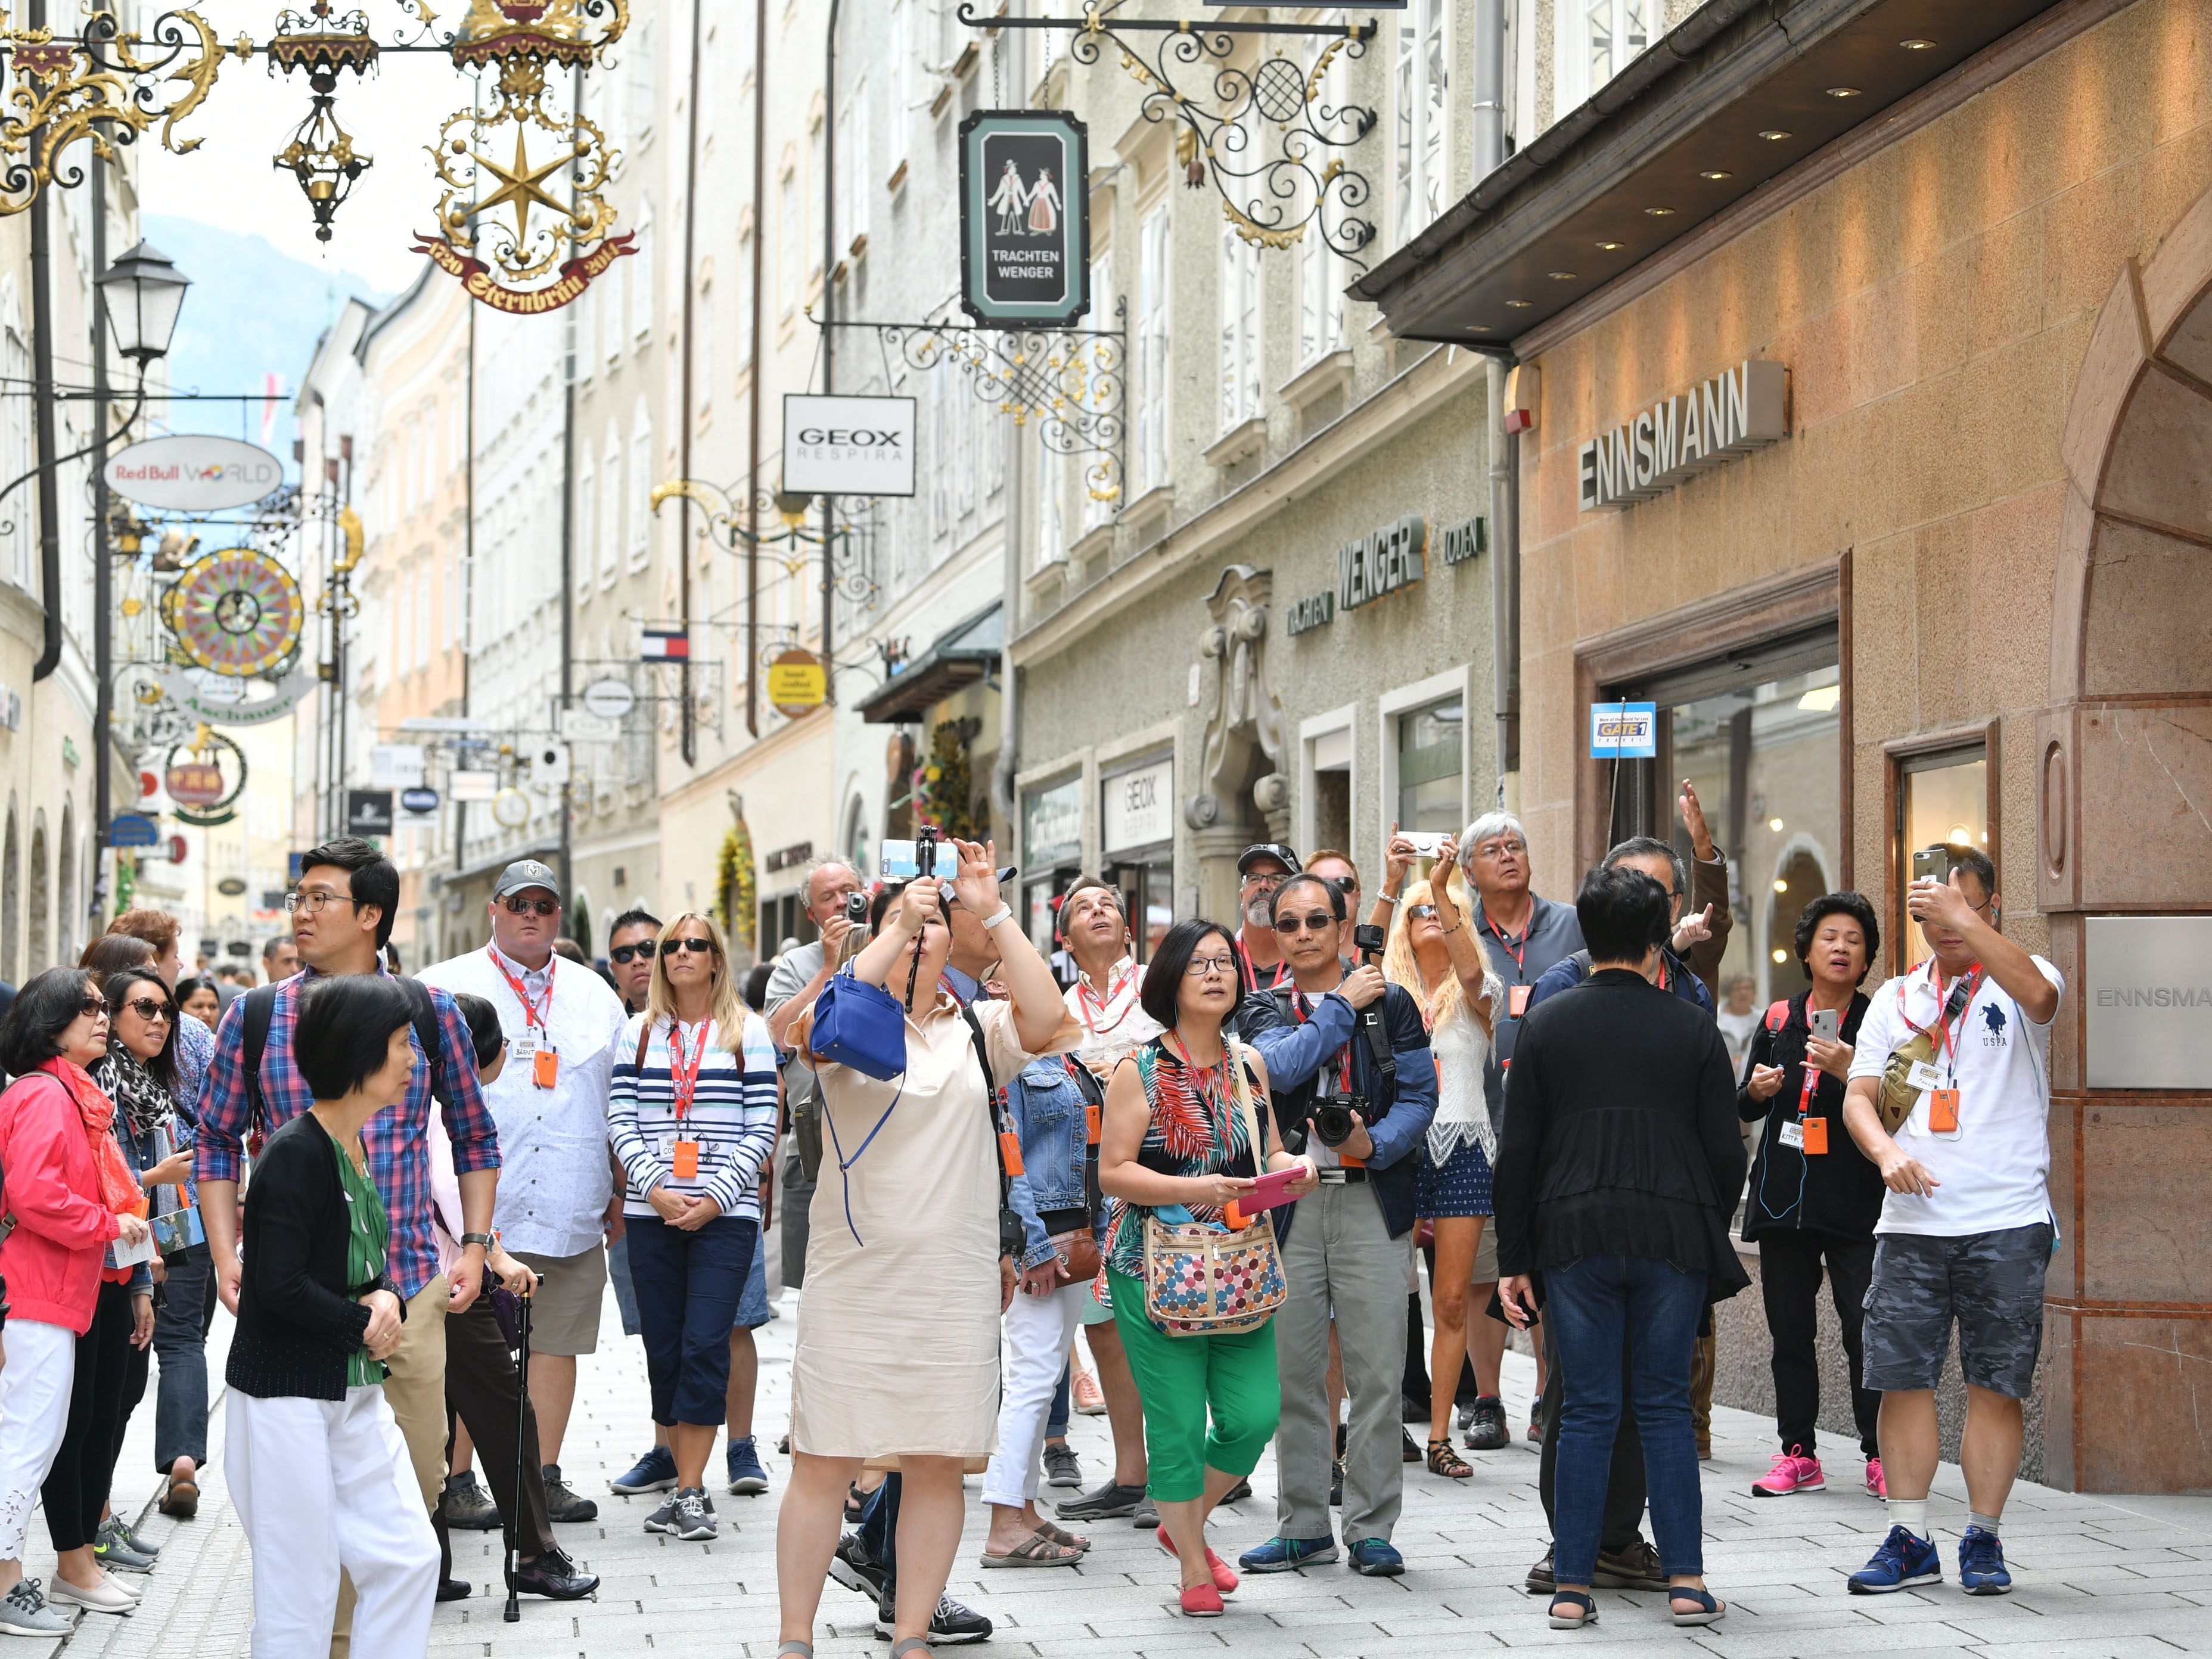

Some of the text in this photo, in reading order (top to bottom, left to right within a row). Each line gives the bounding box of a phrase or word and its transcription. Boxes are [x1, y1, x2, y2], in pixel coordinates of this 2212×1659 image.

[992, 250, 1060, 262] TRACHTEN
[428, 241, 464, 275] 1720
[467, 272, 585, 312] Sternbräu
[998, 266, 1054, 278] WENGER
[799, 428, 901, 447] GEOX
[1579, 360, 1752, 513] ENNSMANN
[797, 447, 903, 461] RESPIRA
[116, 464, 147, 480] Red
[150, 464, 179, 480] Bull
[1340, 514, 1415, 609] WENGER
[1125, 775, 1156, 812] GEOX
[2097, 987, 2212, 1007] ENNSMA
[1983, 1037, 2008, 1047] USPA
